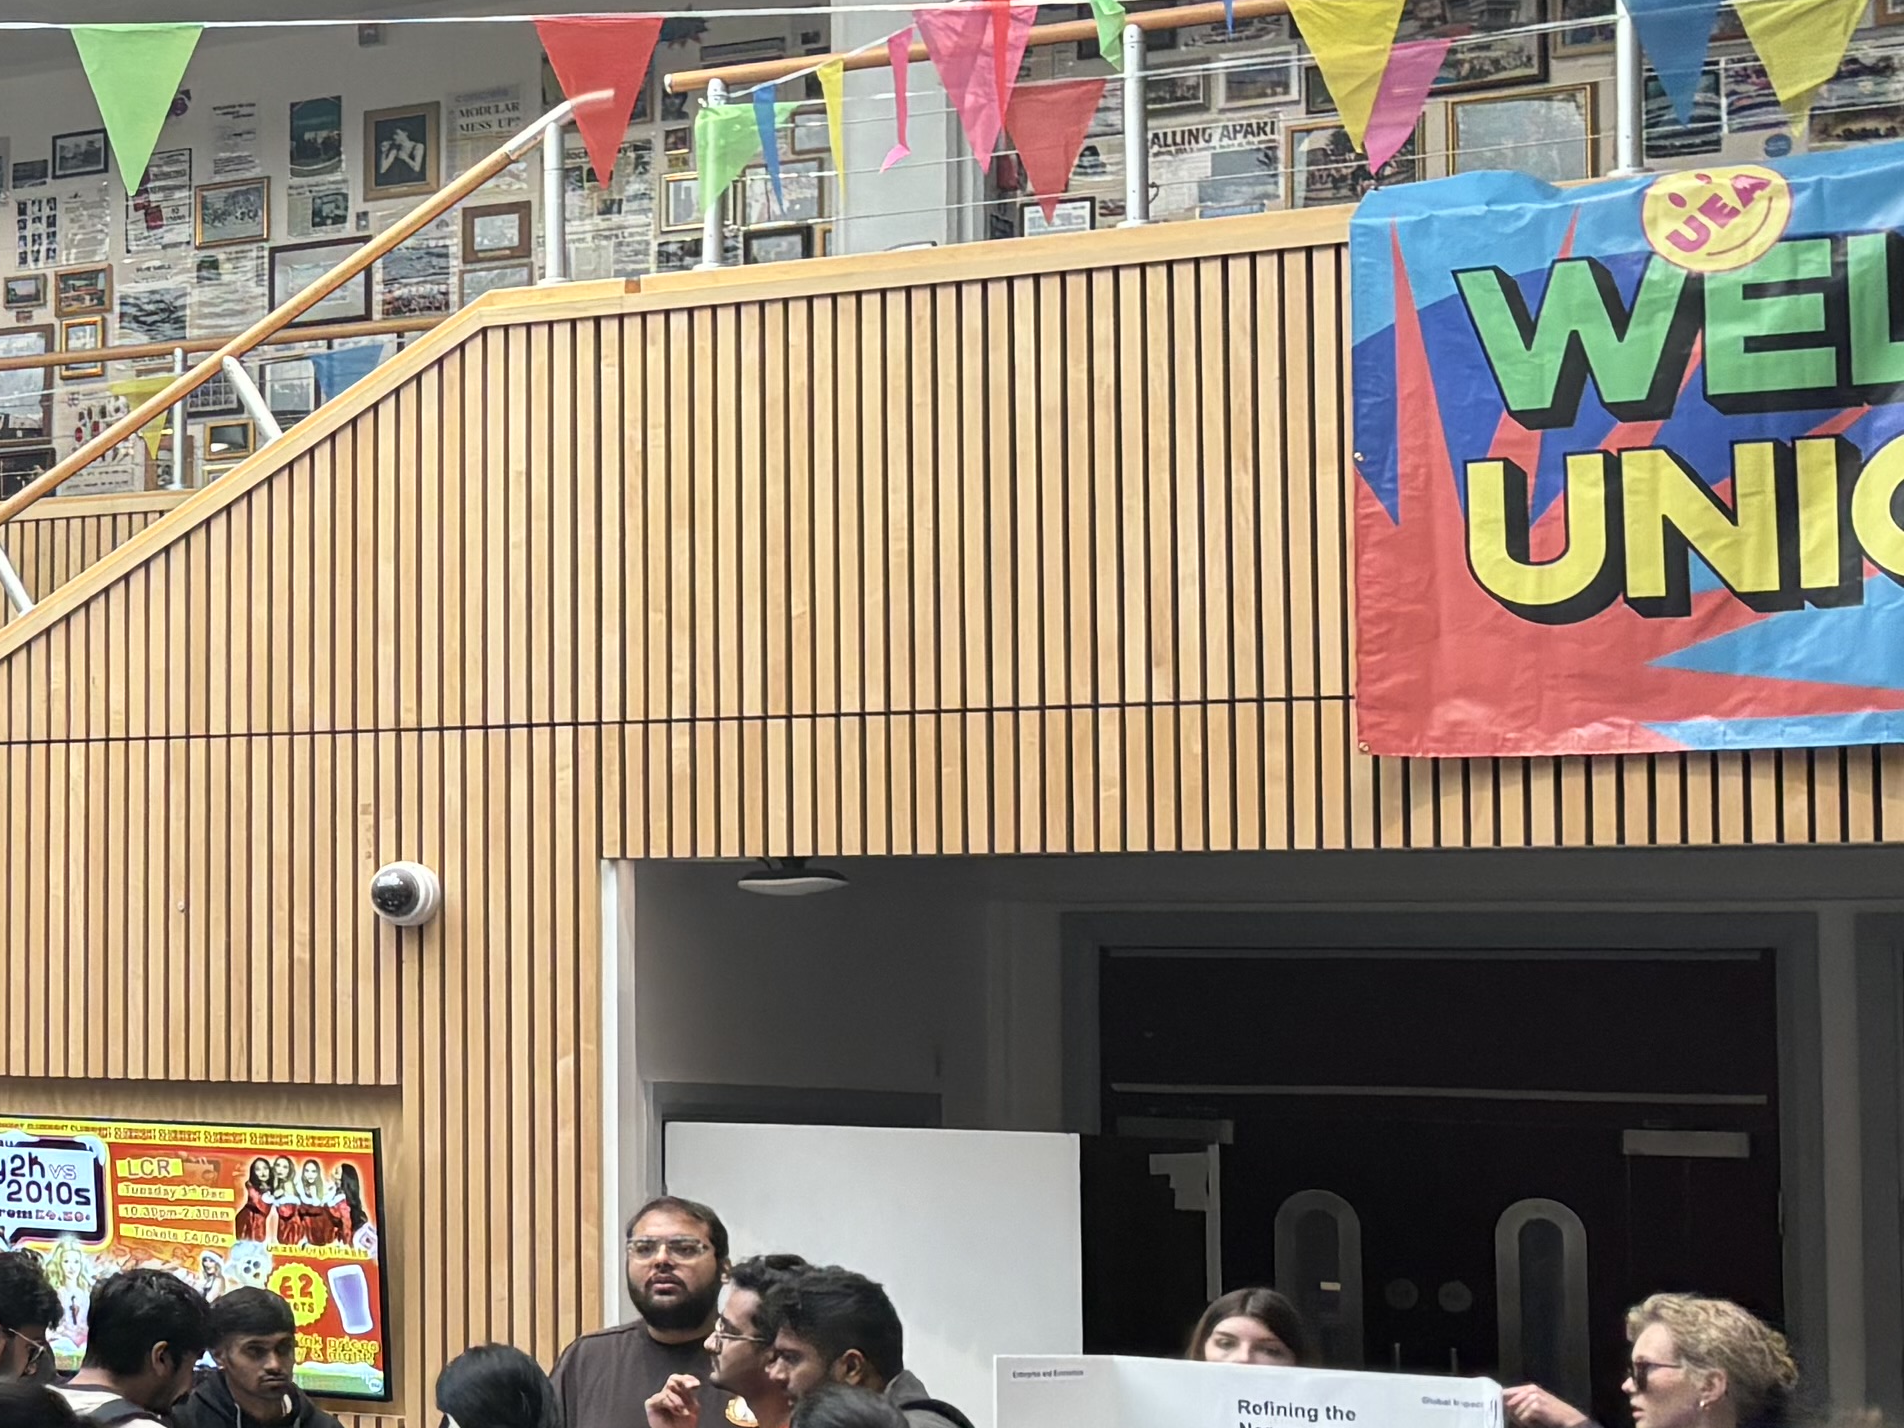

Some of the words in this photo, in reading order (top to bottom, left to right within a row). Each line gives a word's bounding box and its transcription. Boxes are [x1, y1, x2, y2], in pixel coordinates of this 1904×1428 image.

[458, 101, 521, 120] MODULAR
[459, 121, 491, 135] MESS
[1147, 122, 1214, 151] ALLING
[1665, 172, 1774, 255] UEA
[126, 1159, 171, 1177] LCR
[6, 1179, 92, 1206] 2010s
[123, 1183, 178, 1200] Tuesday
[200, 1188, 227, 1200] Dec
[133, 1226, 180, 1242] Tickets
[279, 1273, 314, 1300] £2
[1237, 1398, 1319, 1423] Refining
[1324, 1405, 1356, 1422] the
